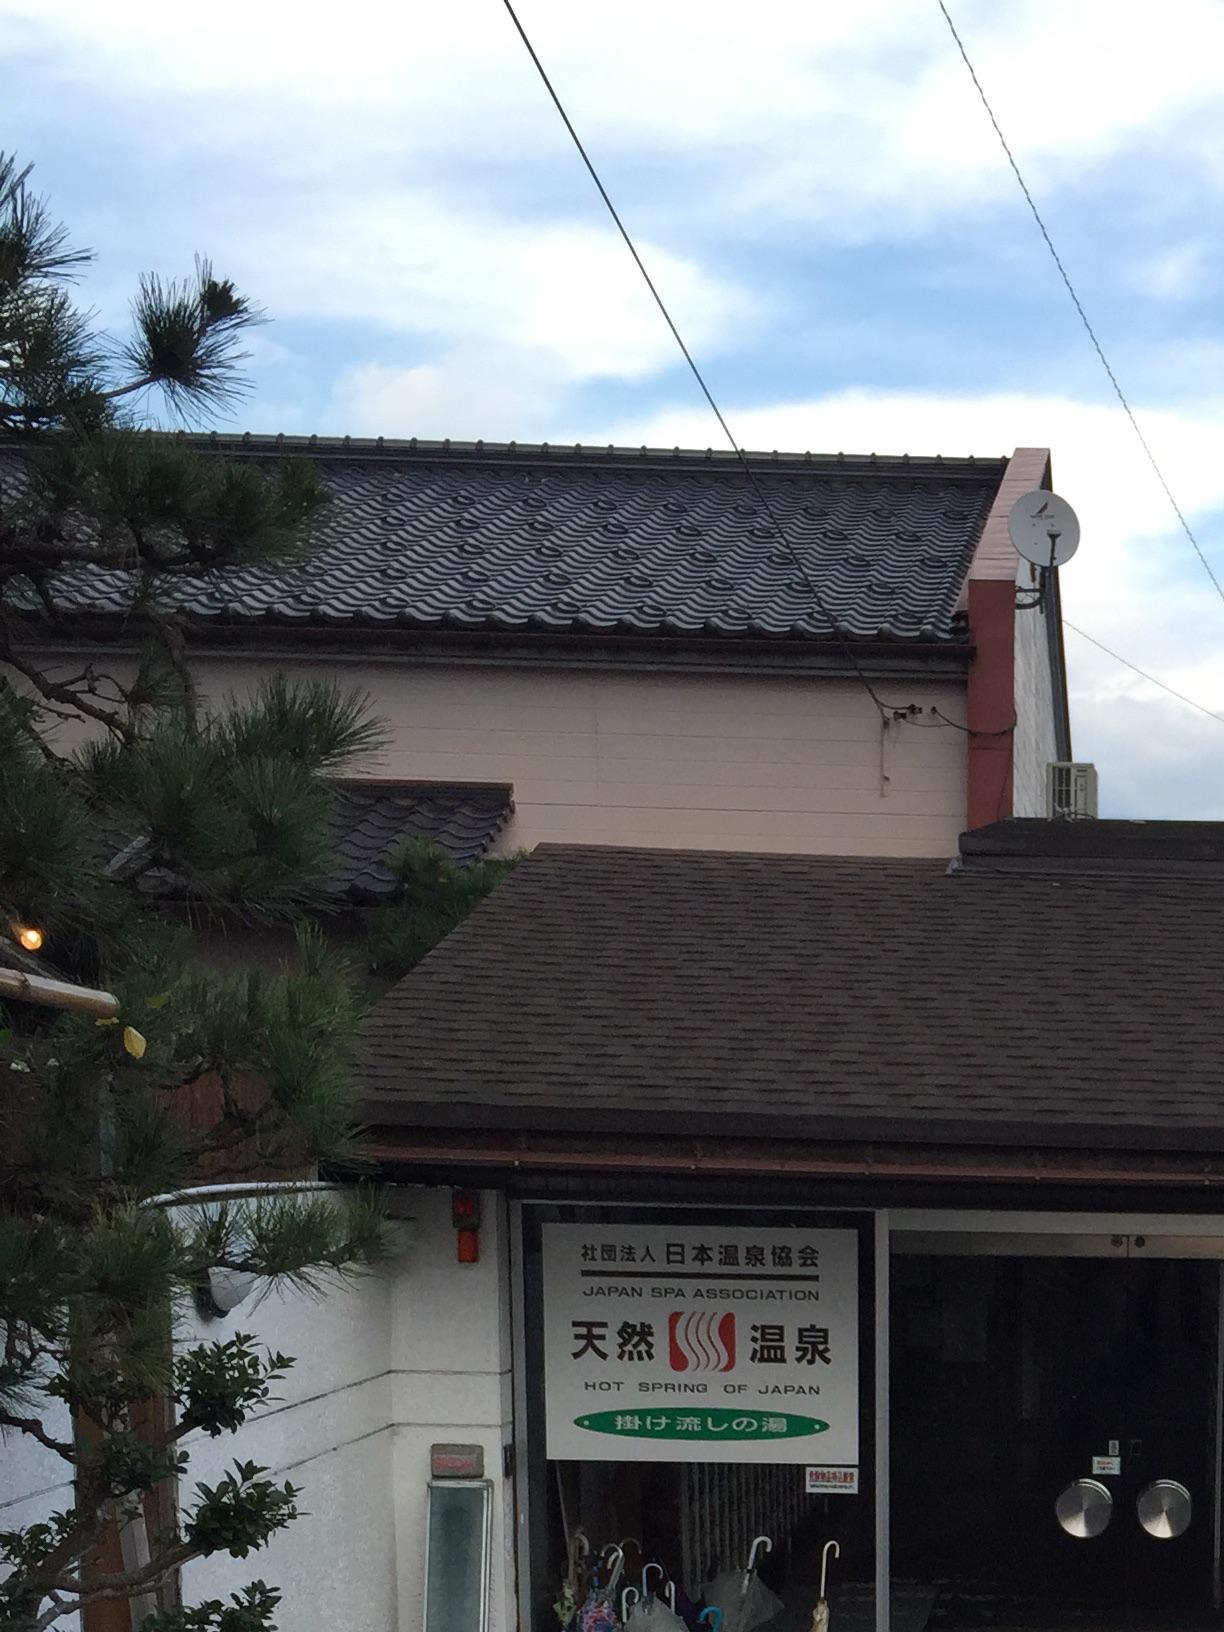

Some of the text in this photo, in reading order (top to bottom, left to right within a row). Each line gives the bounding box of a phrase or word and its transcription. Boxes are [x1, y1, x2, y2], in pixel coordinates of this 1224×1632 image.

[582, 1286, 820, 1301] JAPAN SPA ASSOCIATION
[571, 1320, 832, 1366] 天然 温泉
[584, 1381, 821, 1396] HOT SPRING OF JAPAN
[615, 1415, 788, 1433] 掛け流しの湯
